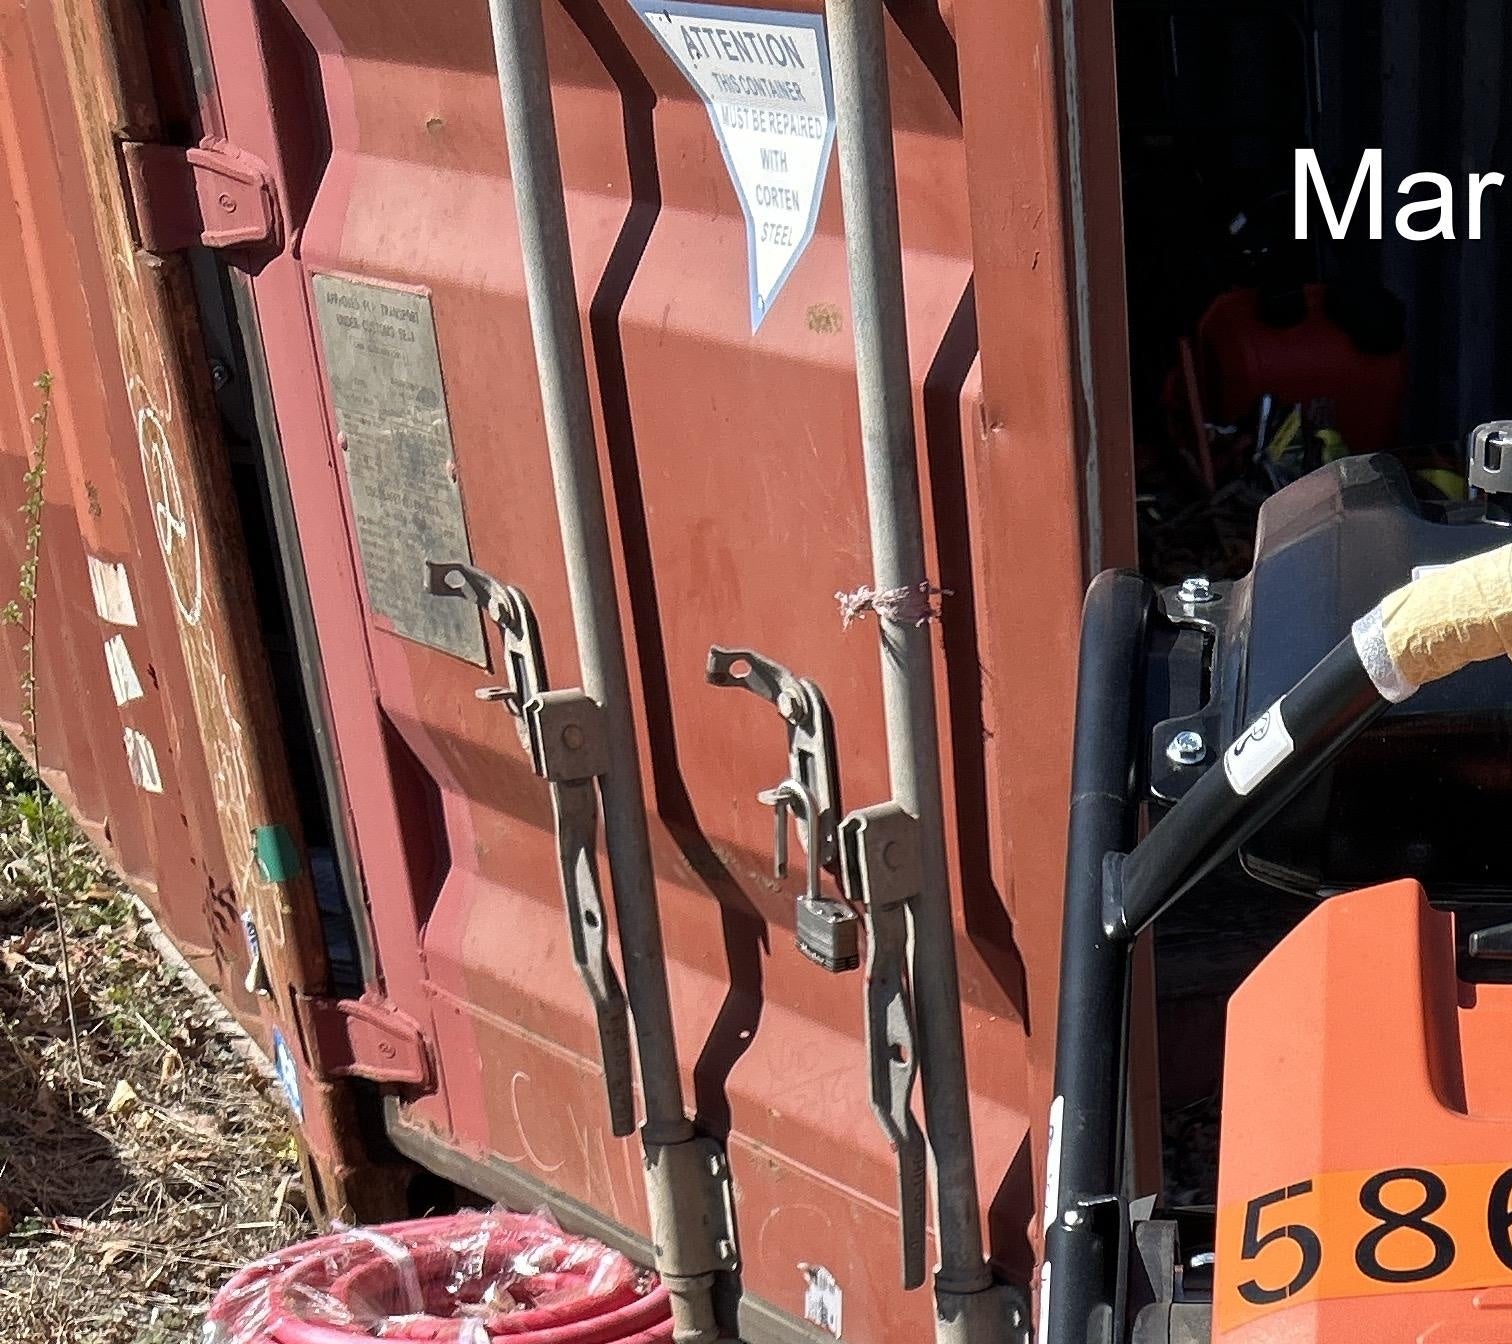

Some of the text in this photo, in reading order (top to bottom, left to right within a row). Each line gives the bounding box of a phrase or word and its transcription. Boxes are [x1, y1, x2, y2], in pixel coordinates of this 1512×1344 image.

[681, 25, 805, 69] ATTENTION
[712, 72, 806, 102] THIS CONTAINER
[721, 104, 822, 140] MUST BE REPAIRED
[760, 148, 788, 172] WITH
[756, 184, 800, 211] CORTEN
[761, 222, 792, 246] STEEL
